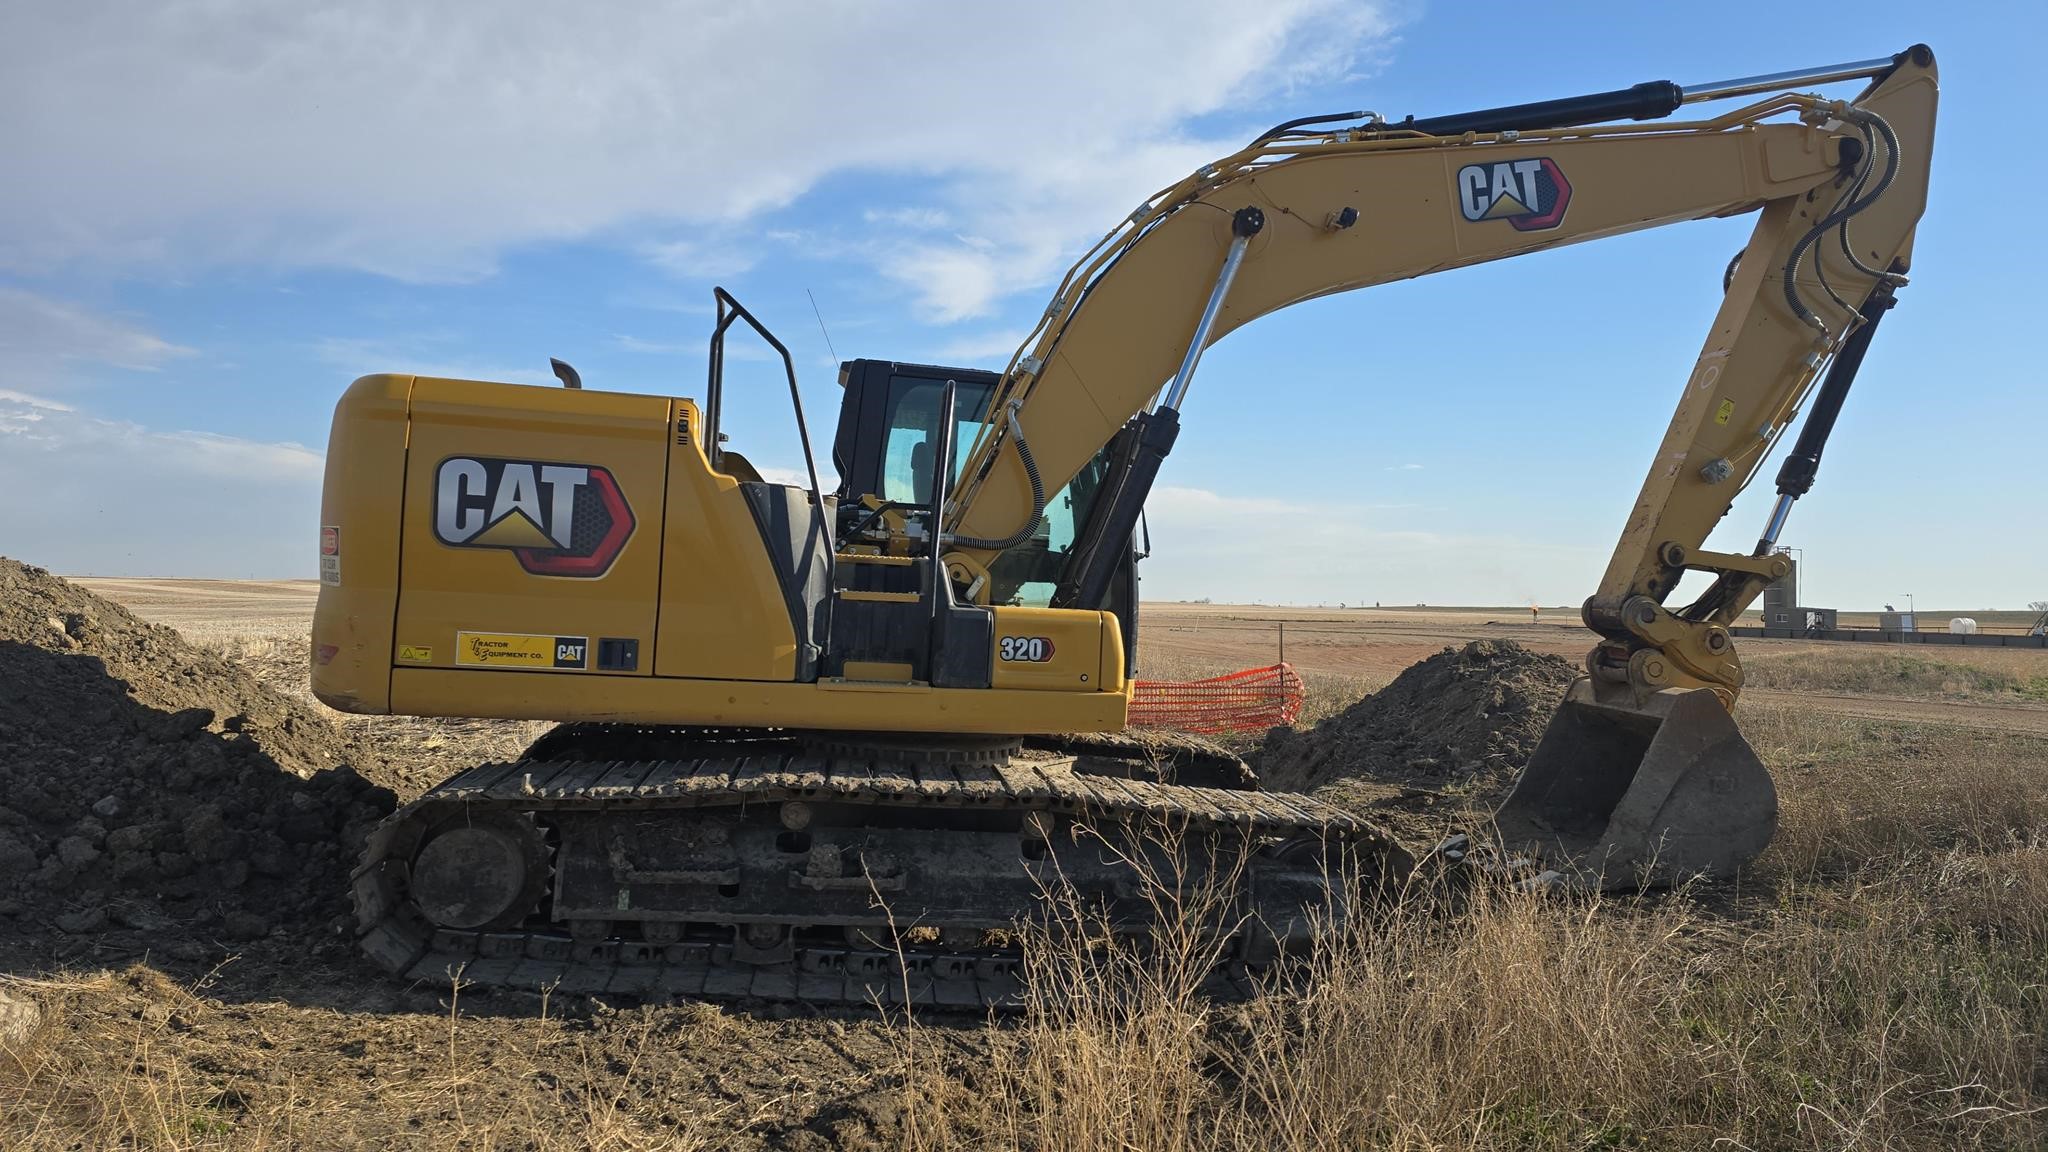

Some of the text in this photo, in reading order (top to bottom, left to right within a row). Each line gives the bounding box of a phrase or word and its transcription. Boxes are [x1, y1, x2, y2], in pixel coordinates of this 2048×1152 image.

[1459, 160, 1541, 220] CAT
[437, 459, 588, 549] CAT
[471, 637, 509, 650] TRACTOR
[557, 645, 584, 661] CAT
[1001, 637, 1042, 660] 320
[480, 648, 528, 661] EQUIPMENT
